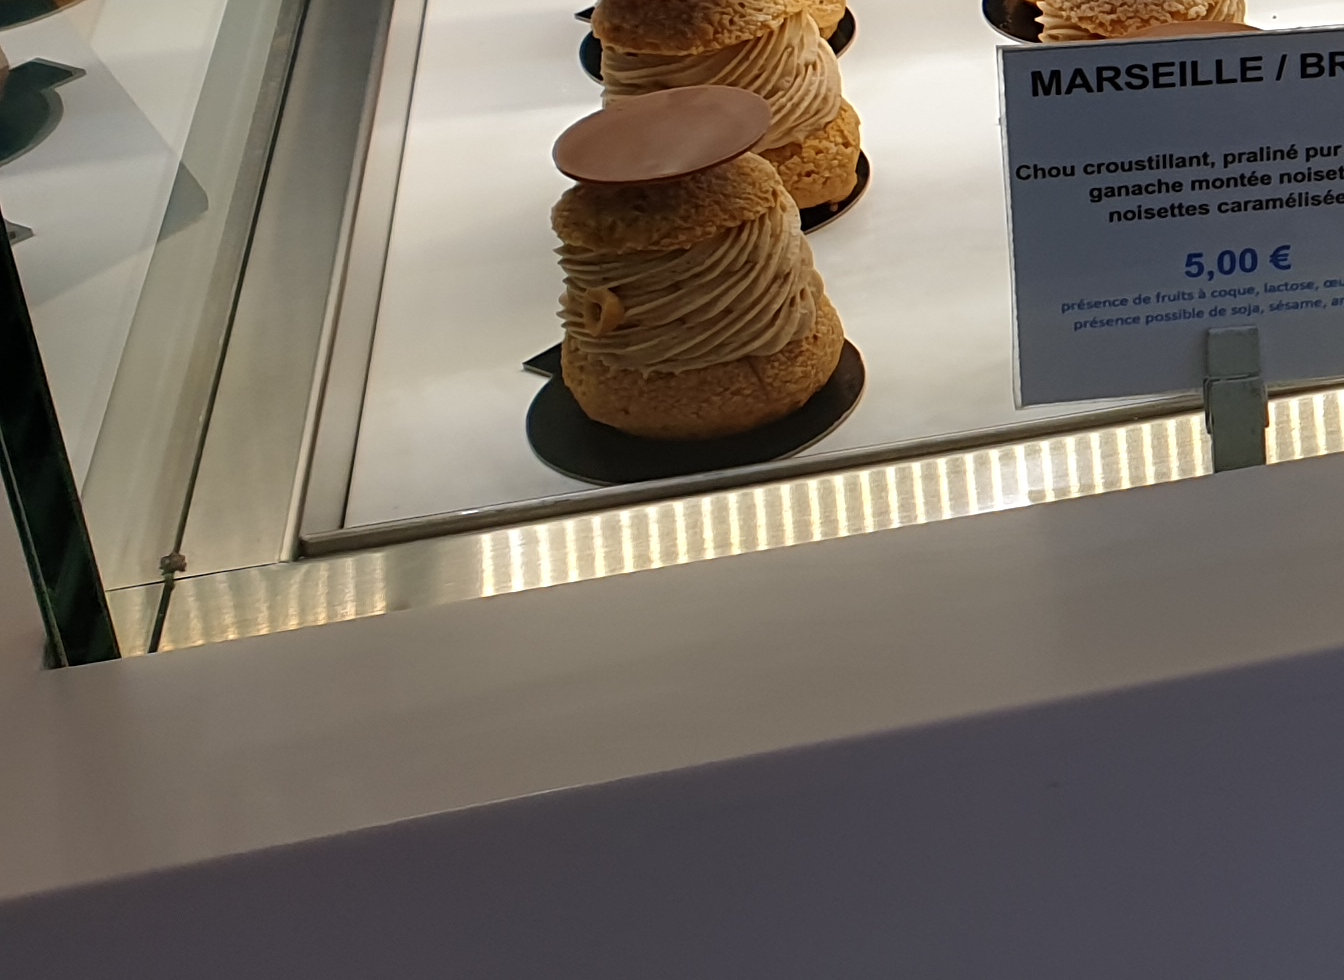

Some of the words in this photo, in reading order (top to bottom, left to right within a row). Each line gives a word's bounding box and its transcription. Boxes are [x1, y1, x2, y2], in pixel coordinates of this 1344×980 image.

[1030, 56, 1264, 97] MARSEILLE
[1276, 53, 1287, 81] /
[1015, 164, 1076, 181] Chou
[1083, 151, 1217, 175] croustillant,
[1223, 145, 1298, 169] praliné
[1305, 143, 1342, 162] pur
[1089, 178, 1183, 203] ganache
[1190, 171, 1272, 191] montée
[1108, 202, 1210, 223] noisettes
[1184, 248, 1258, 281] 5,00
[1269, 245, 1291, 269] €
[1061, 296, 1129, 313] présence
[1133, 293, 1151, 305] de
[1156, 289, 1194, 303] fruits
[1197, 287, 1207, 299] à
[1210, 284, 1259, 301] coque,
[1264, 279, 1318, 294] lactose,
[1073, 313, 1141, 332] présence
[1145, 307, 1204, 325] possible
[1208, 305, 1226, 317] de
[1231, 301, 1264, 317] soja,
[1269, 296, 1327, 312] sésame,
